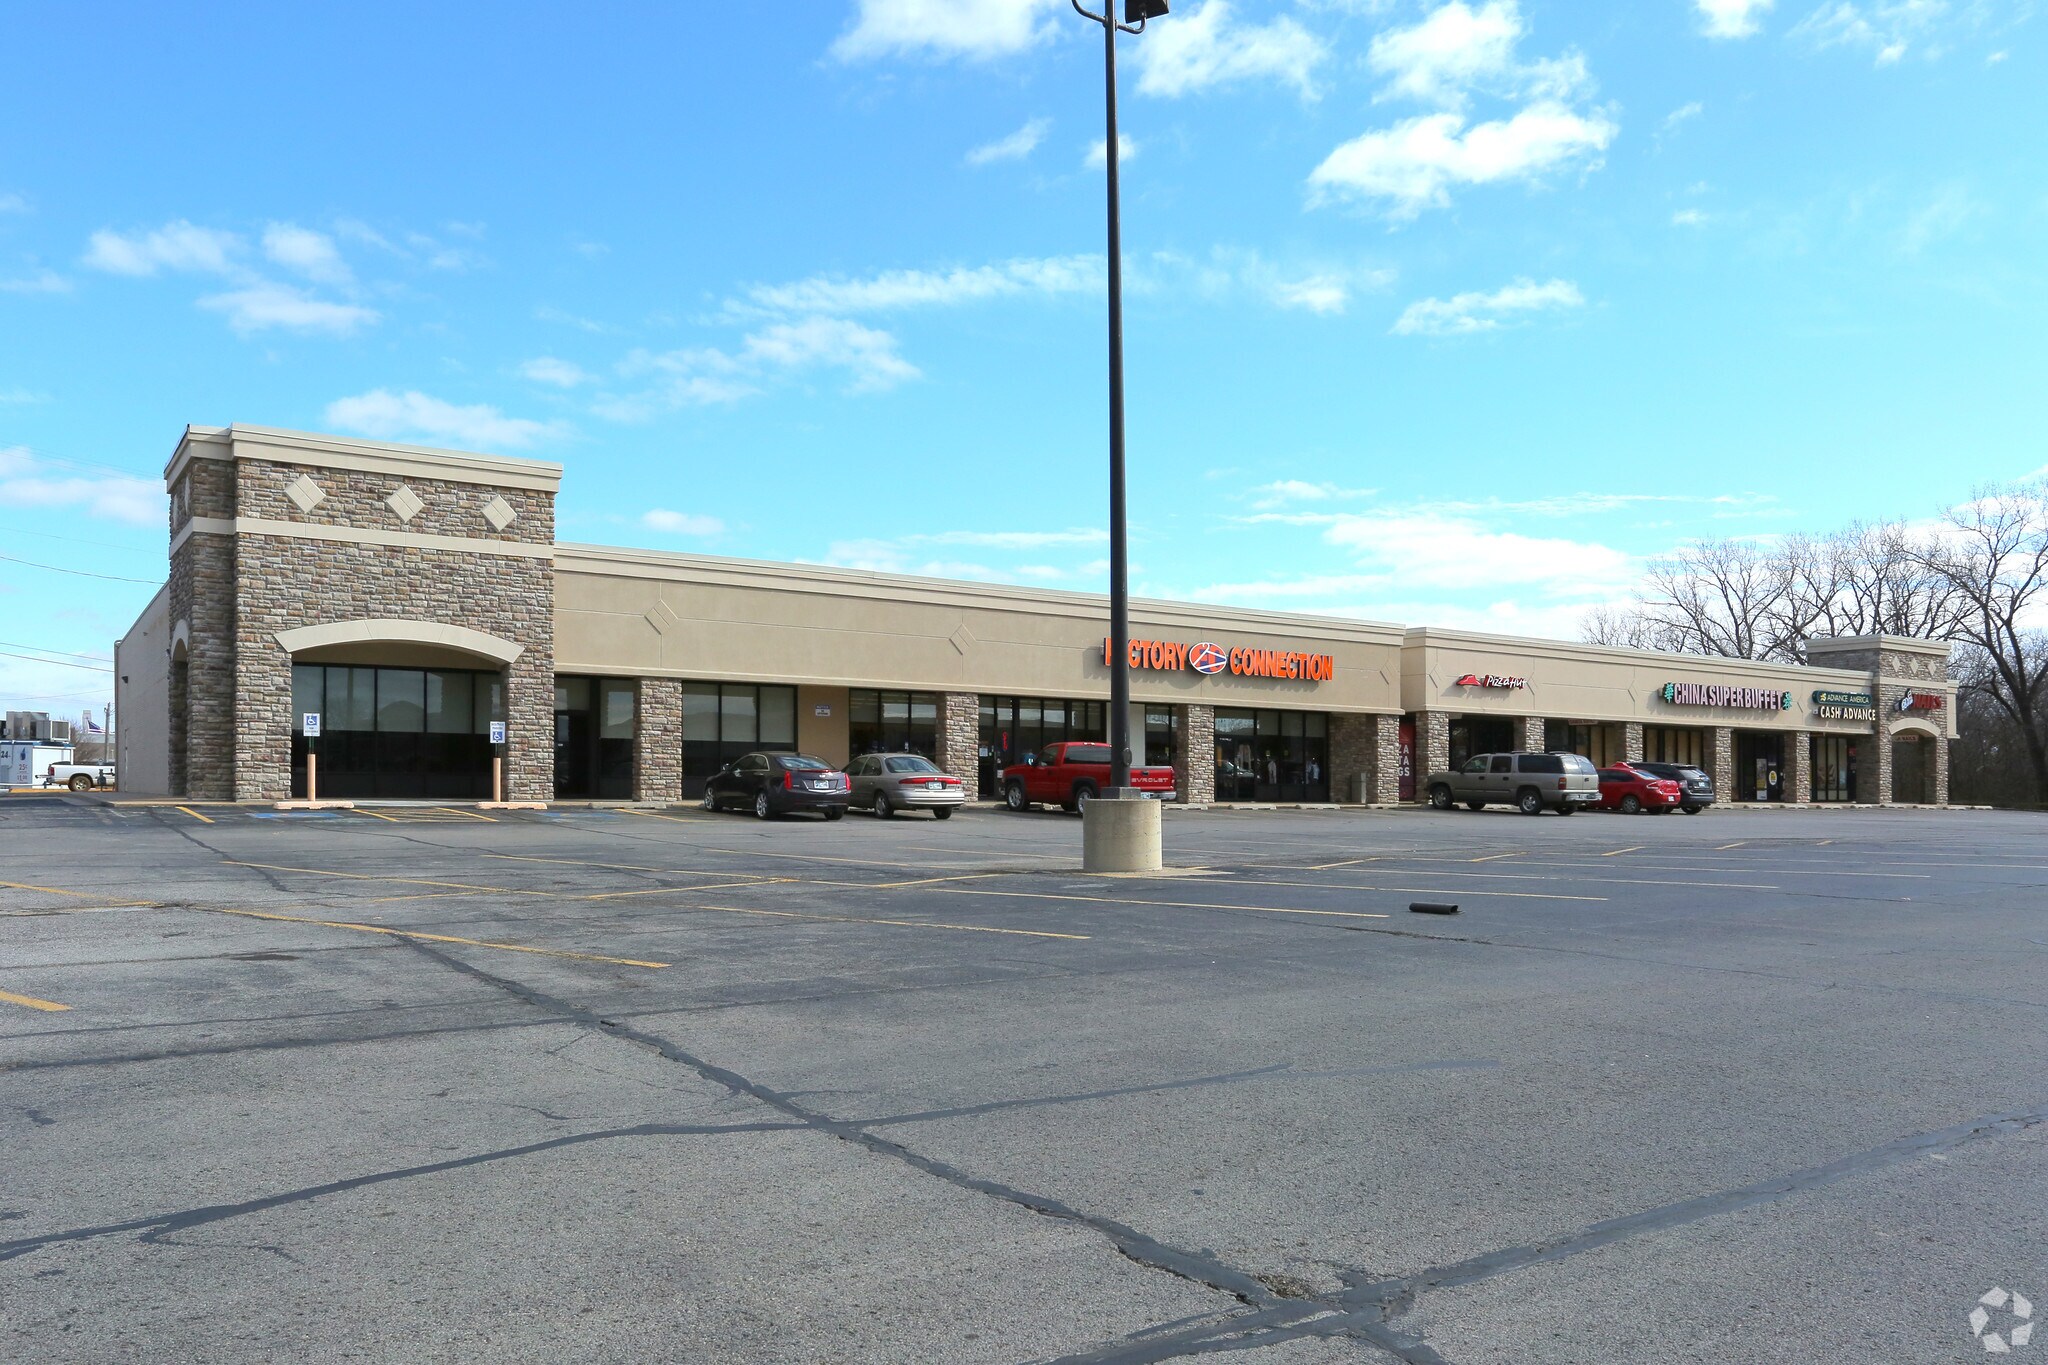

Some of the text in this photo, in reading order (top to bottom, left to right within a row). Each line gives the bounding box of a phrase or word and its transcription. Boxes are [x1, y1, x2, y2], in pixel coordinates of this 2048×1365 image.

[1104, 637, 1188, 671] CTORY
[1229, 646, 1334, 681] CONNECTION
[1674, 682, 1782, 710] CHINA SUPER BUFFET
[1827, 694, 1869, 704] ADVANCE AMERICA
[1820, 705, 1876, 721] CASH ADVANCE
